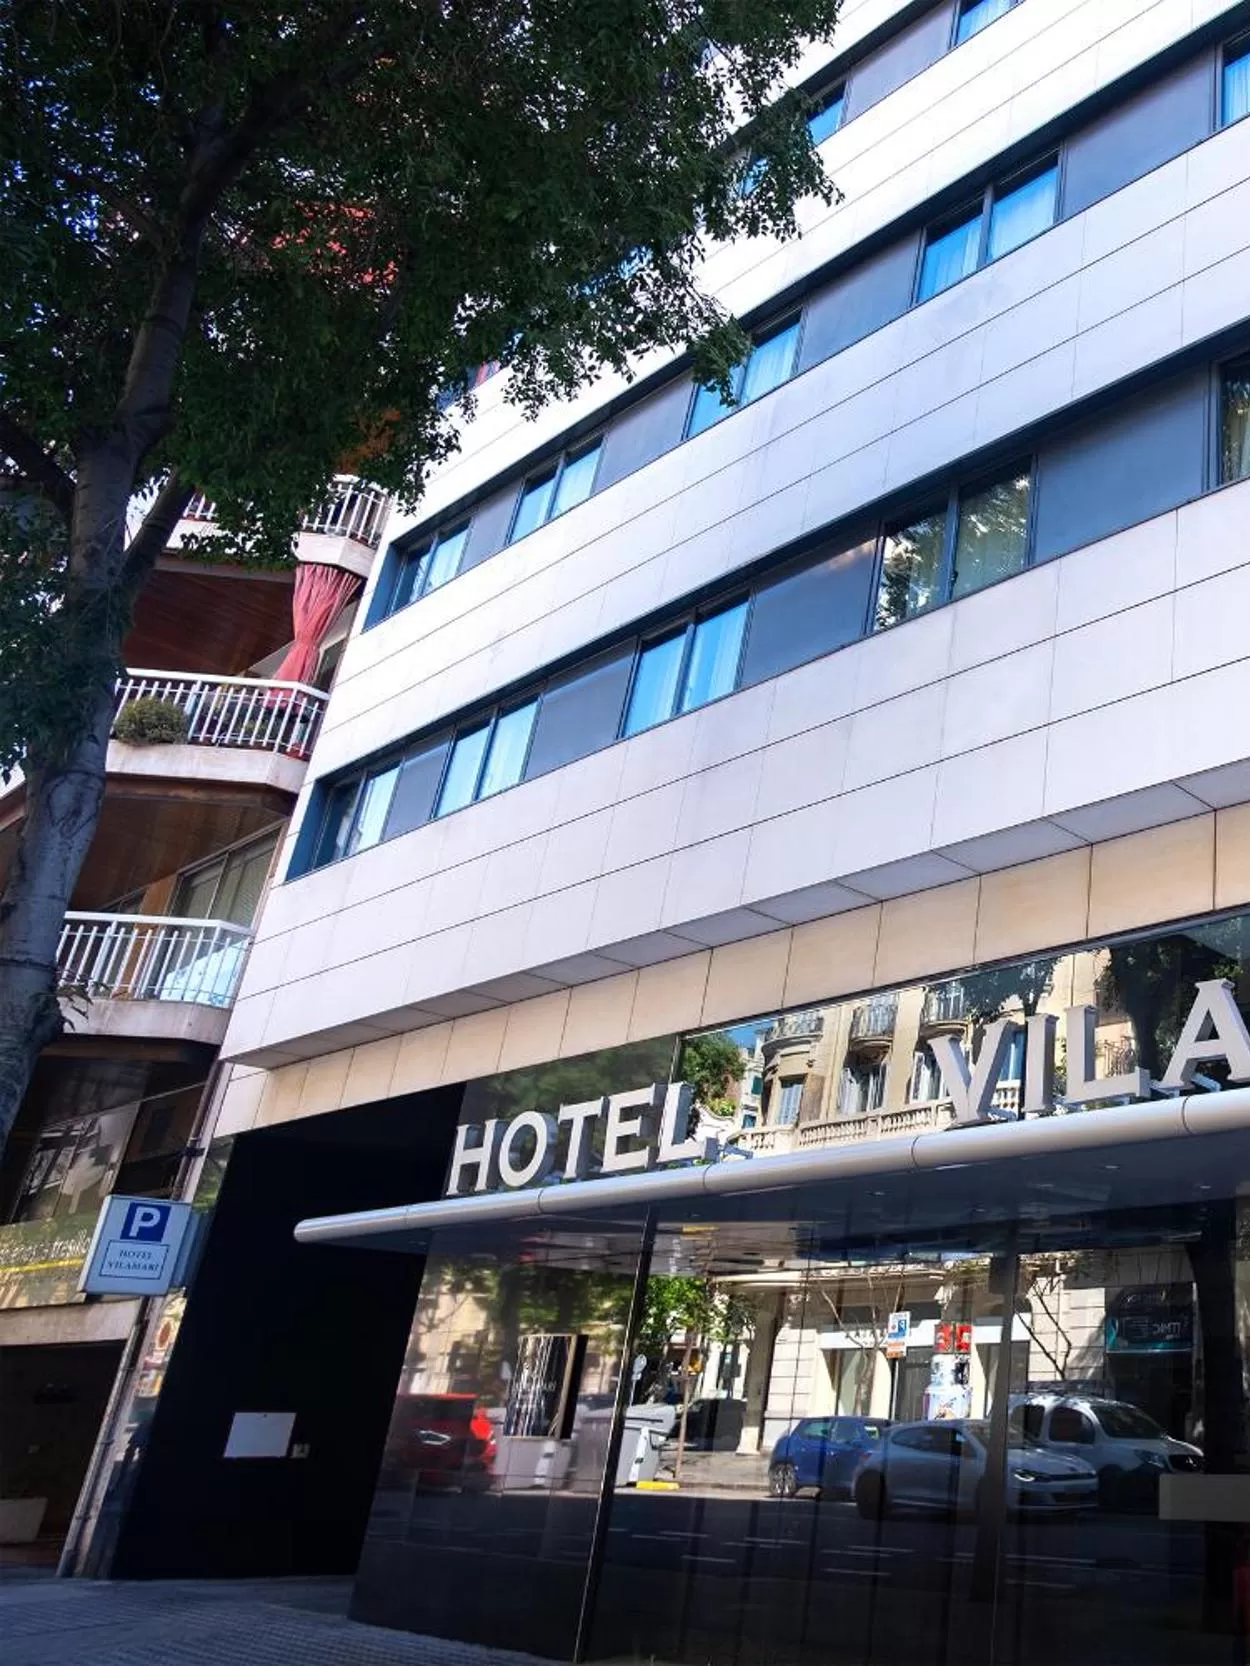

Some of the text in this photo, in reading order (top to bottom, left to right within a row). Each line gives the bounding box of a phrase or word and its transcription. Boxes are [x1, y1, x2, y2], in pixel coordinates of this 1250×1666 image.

[447, 1080, 717, 1196] HOTEL
[128, 1206, 161, 1237] P
[119, 1249, 153, 1260] HOTEL
